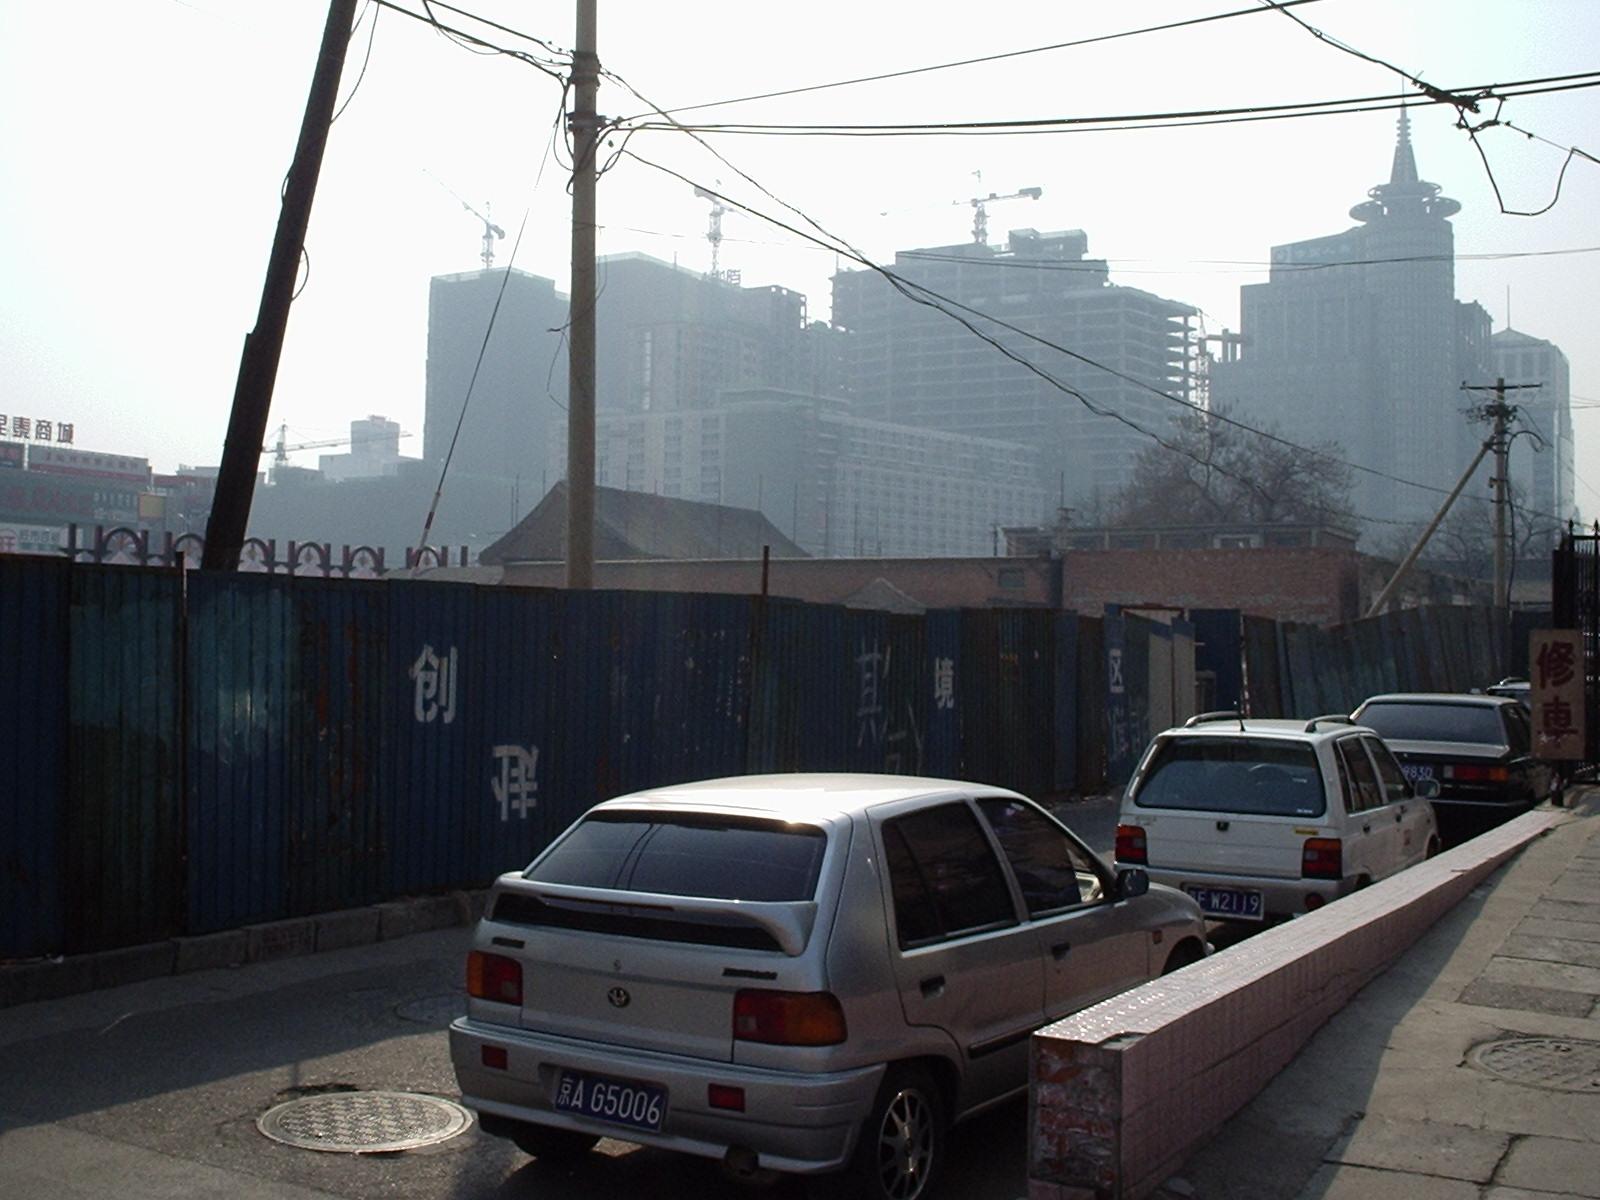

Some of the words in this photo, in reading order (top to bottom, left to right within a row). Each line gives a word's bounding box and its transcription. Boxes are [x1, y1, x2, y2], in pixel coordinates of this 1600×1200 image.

[408, 644, 458, 724] 创
[1536, 640, 1579, 749] 修車
[591, 1082, 661, 1126] G5006
